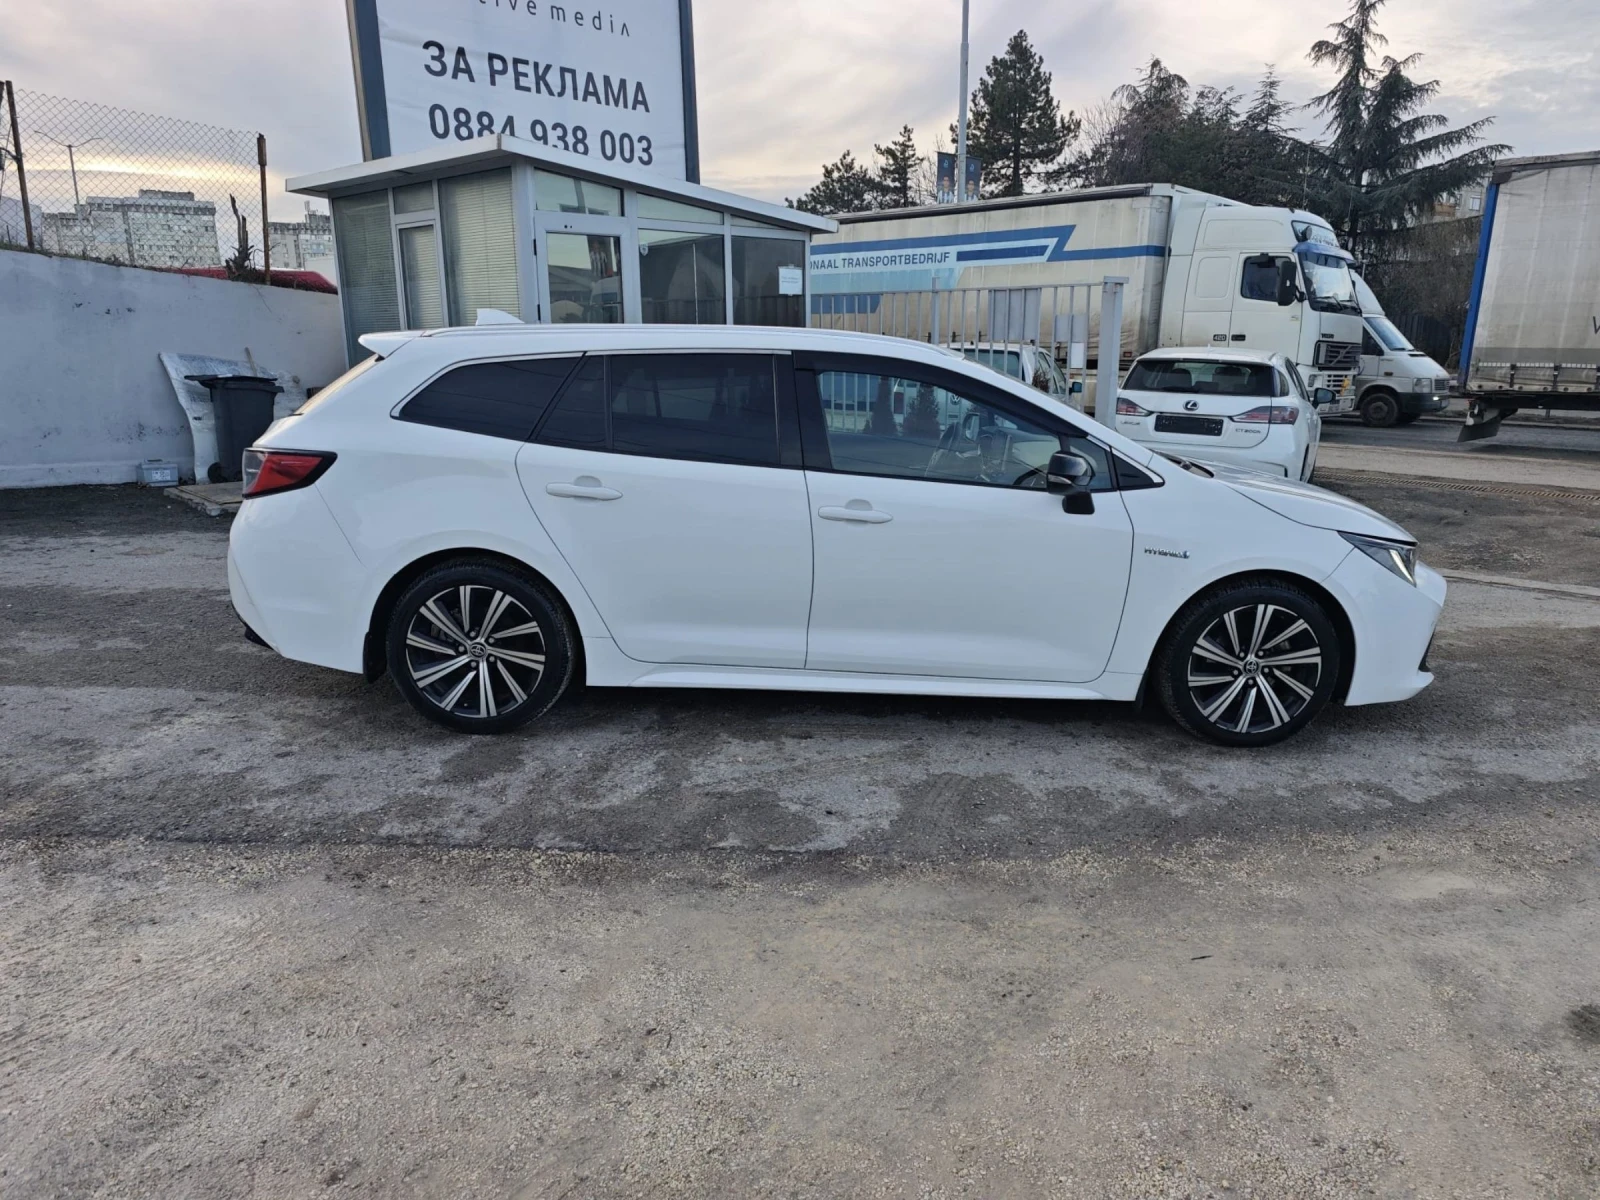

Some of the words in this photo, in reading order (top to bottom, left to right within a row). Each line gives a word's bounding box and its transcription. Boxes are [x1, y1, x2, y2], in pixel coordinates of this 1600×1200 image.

[422, 40, 475, 83] ЗА
[487, 52, 650, 113] РЕКЛАМА
[530, 119, 589, 156] 938
[600, 129, 653, 166] 003
[810, 258, 839, 270] NAAL
[841, 252, 950, 268] TRANSPORTBEDRIJF
